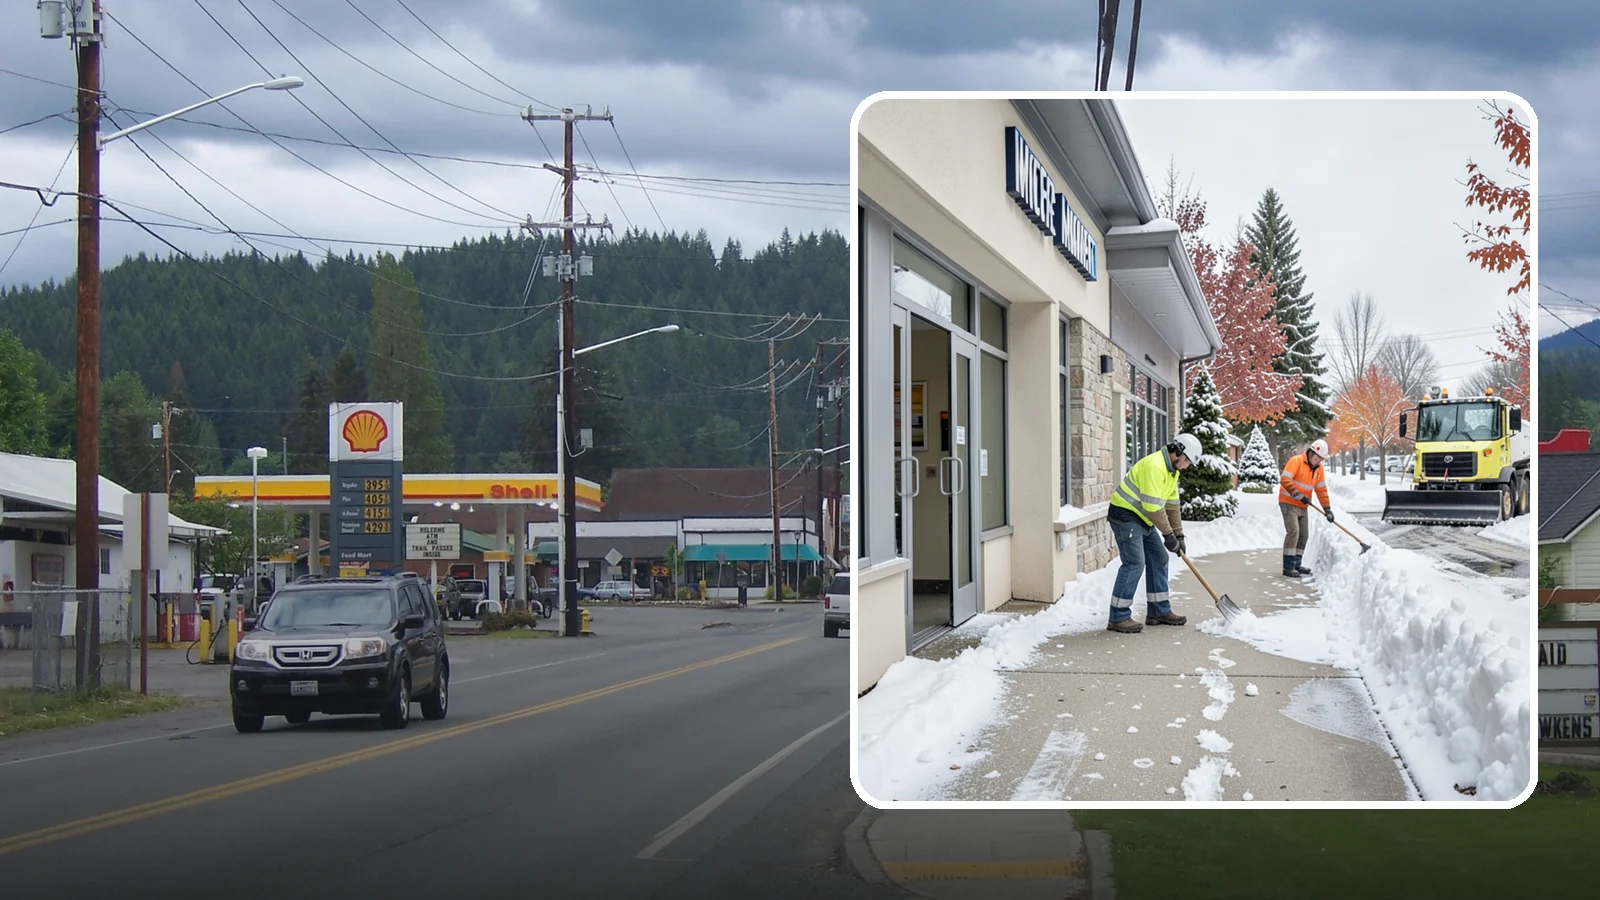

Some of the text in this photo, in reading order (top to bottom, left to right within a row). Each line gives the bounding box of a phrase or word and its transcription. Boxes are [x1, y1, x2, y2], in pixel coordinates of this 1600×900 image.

[365, 480, 383, 490] 395
[490, 484, 547, 499] Shell
[365, 494, 383, 504] 405
[365, 508, 383, 518] 415
[365, 522, 383, 532] 429
